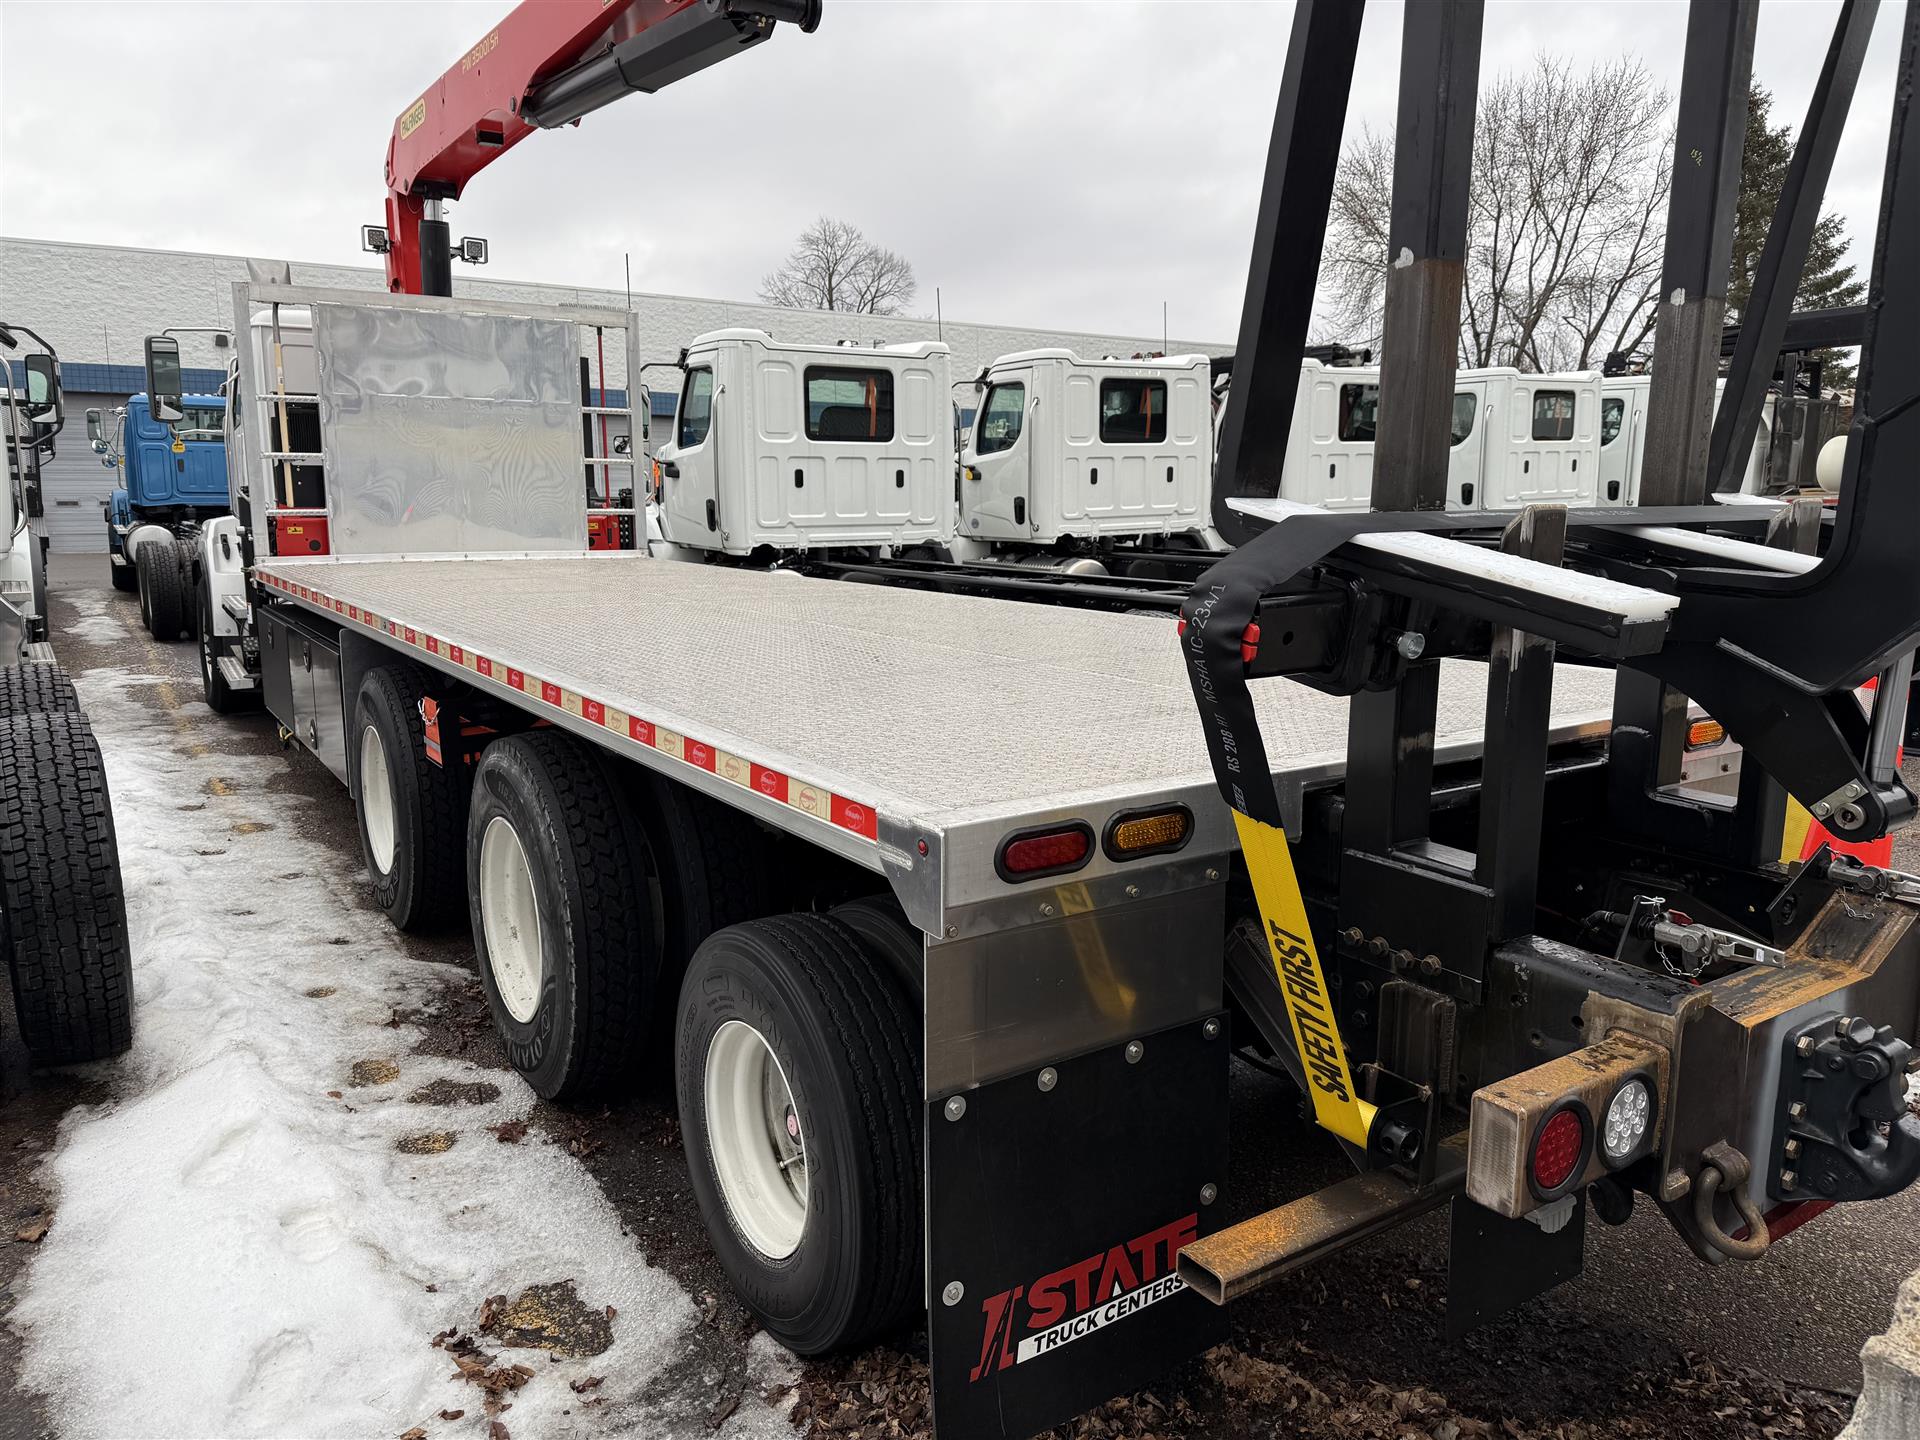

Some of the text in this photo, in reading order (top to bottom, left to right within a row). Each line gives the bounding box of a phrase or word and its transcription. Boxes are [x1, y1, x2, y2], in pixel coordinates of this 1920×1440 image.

[1190, 583, 1227, 654] IC-234/1
[1194, 659, 1219, 704] MSHA
[1226, 756, 1240, 773] RS
[1268, 918, 1350, 1103] SAFETY FIRST
[1026, 1212, 1199, 1330] STATE
[1033, 1274, 1184, 1354] TRUCK CENTERS
